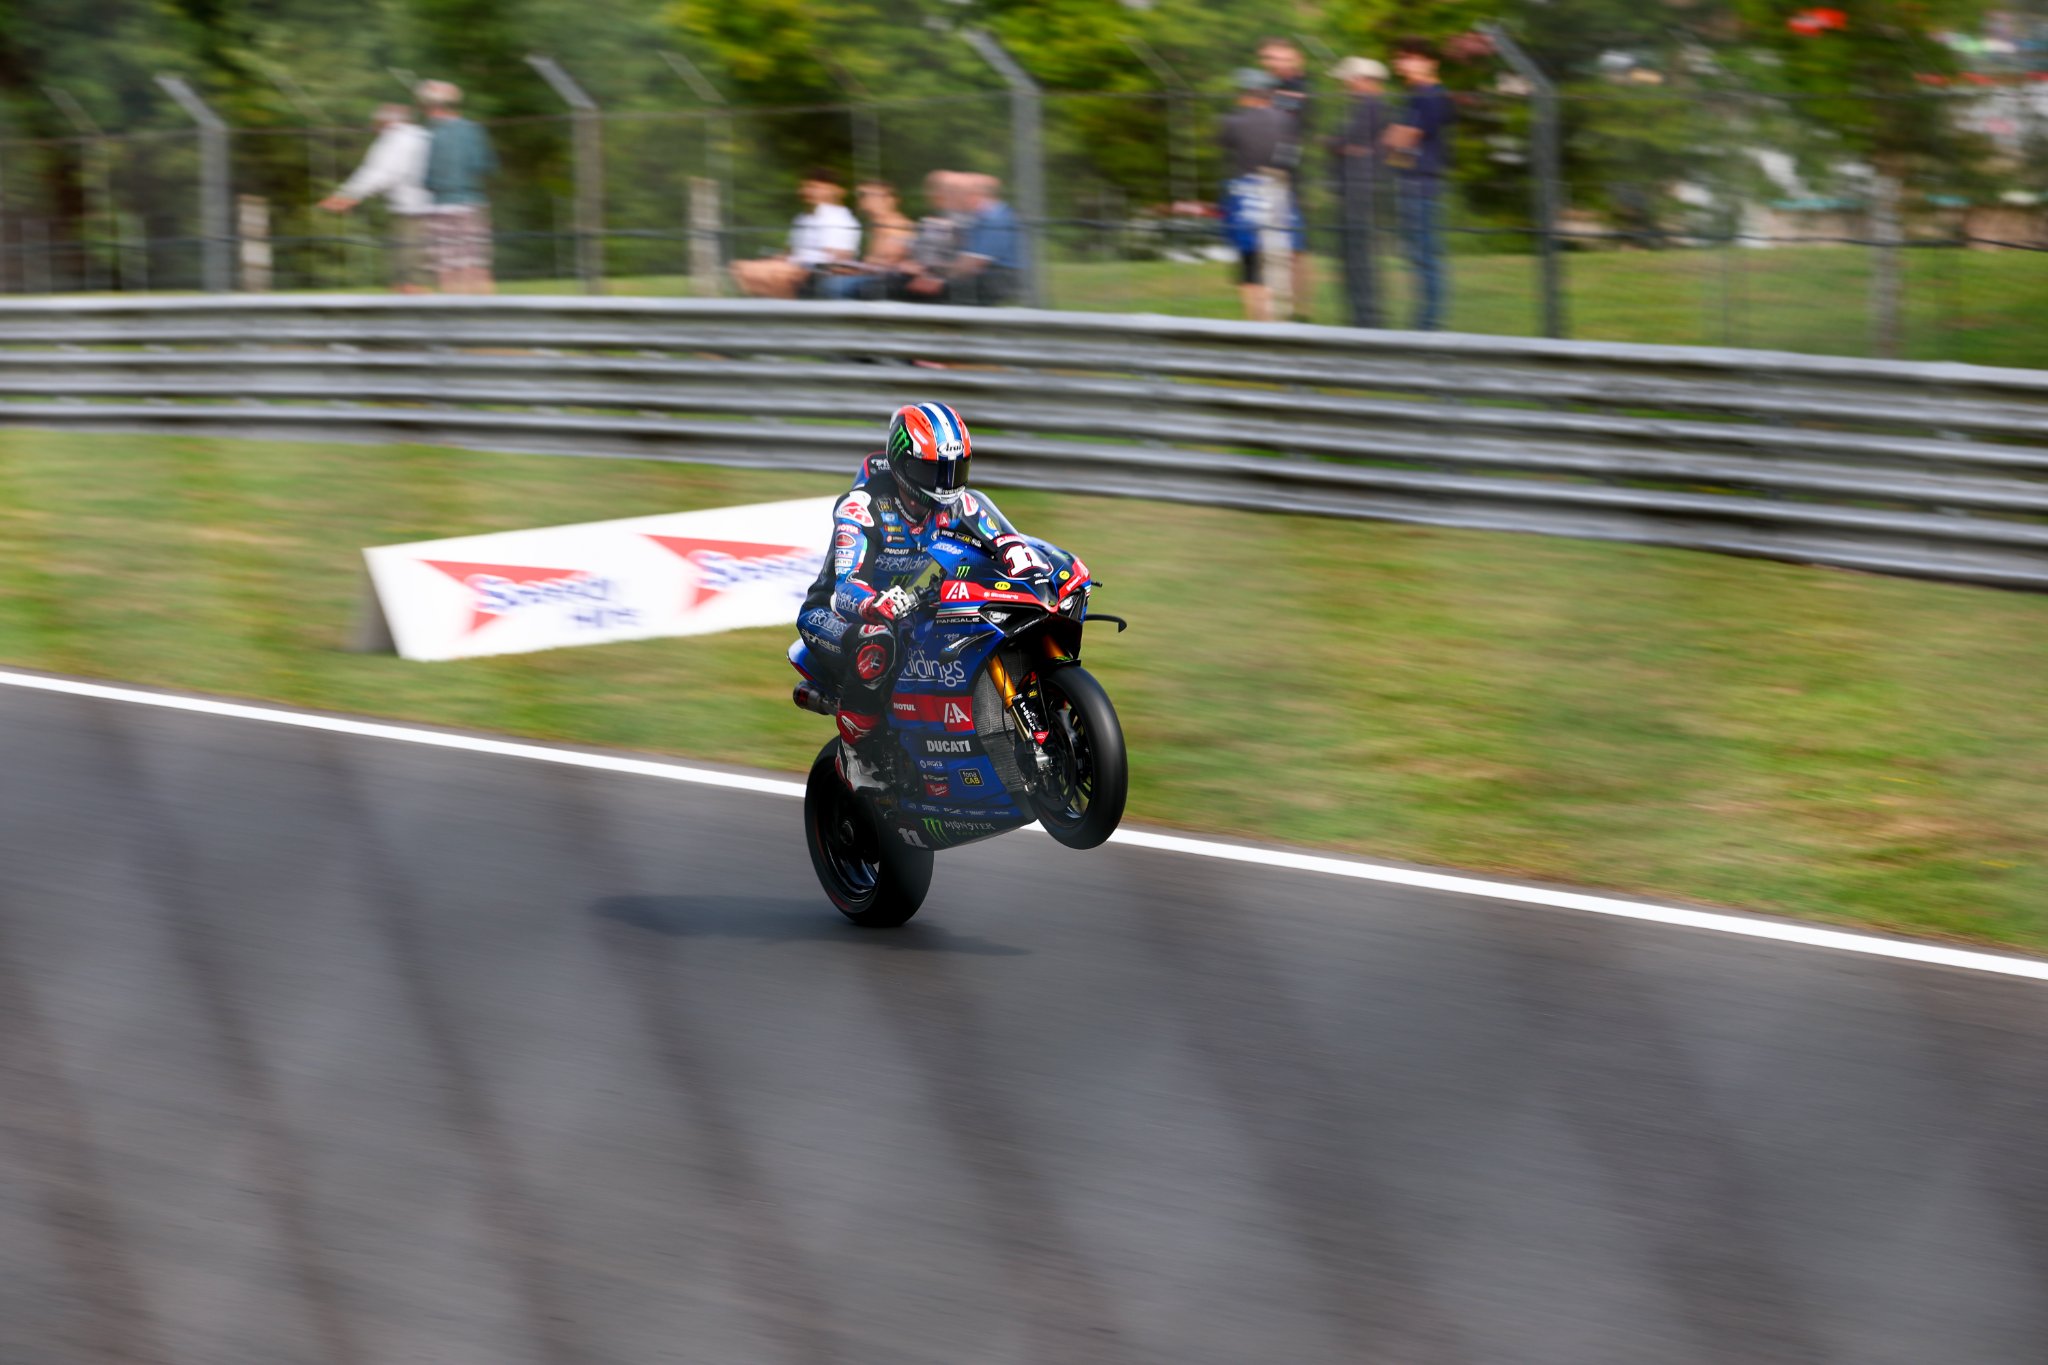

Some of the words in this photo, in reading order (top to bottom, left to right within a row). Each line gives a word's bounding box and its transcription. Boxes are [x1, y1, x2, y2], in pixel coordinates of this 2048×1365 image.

[884, 547, 910, 555] DUCATI
[893, 703, 916, 711] MOTUL
[926, 740, 972, 753] DUCATI
[898, 828, 930, 849] 11
